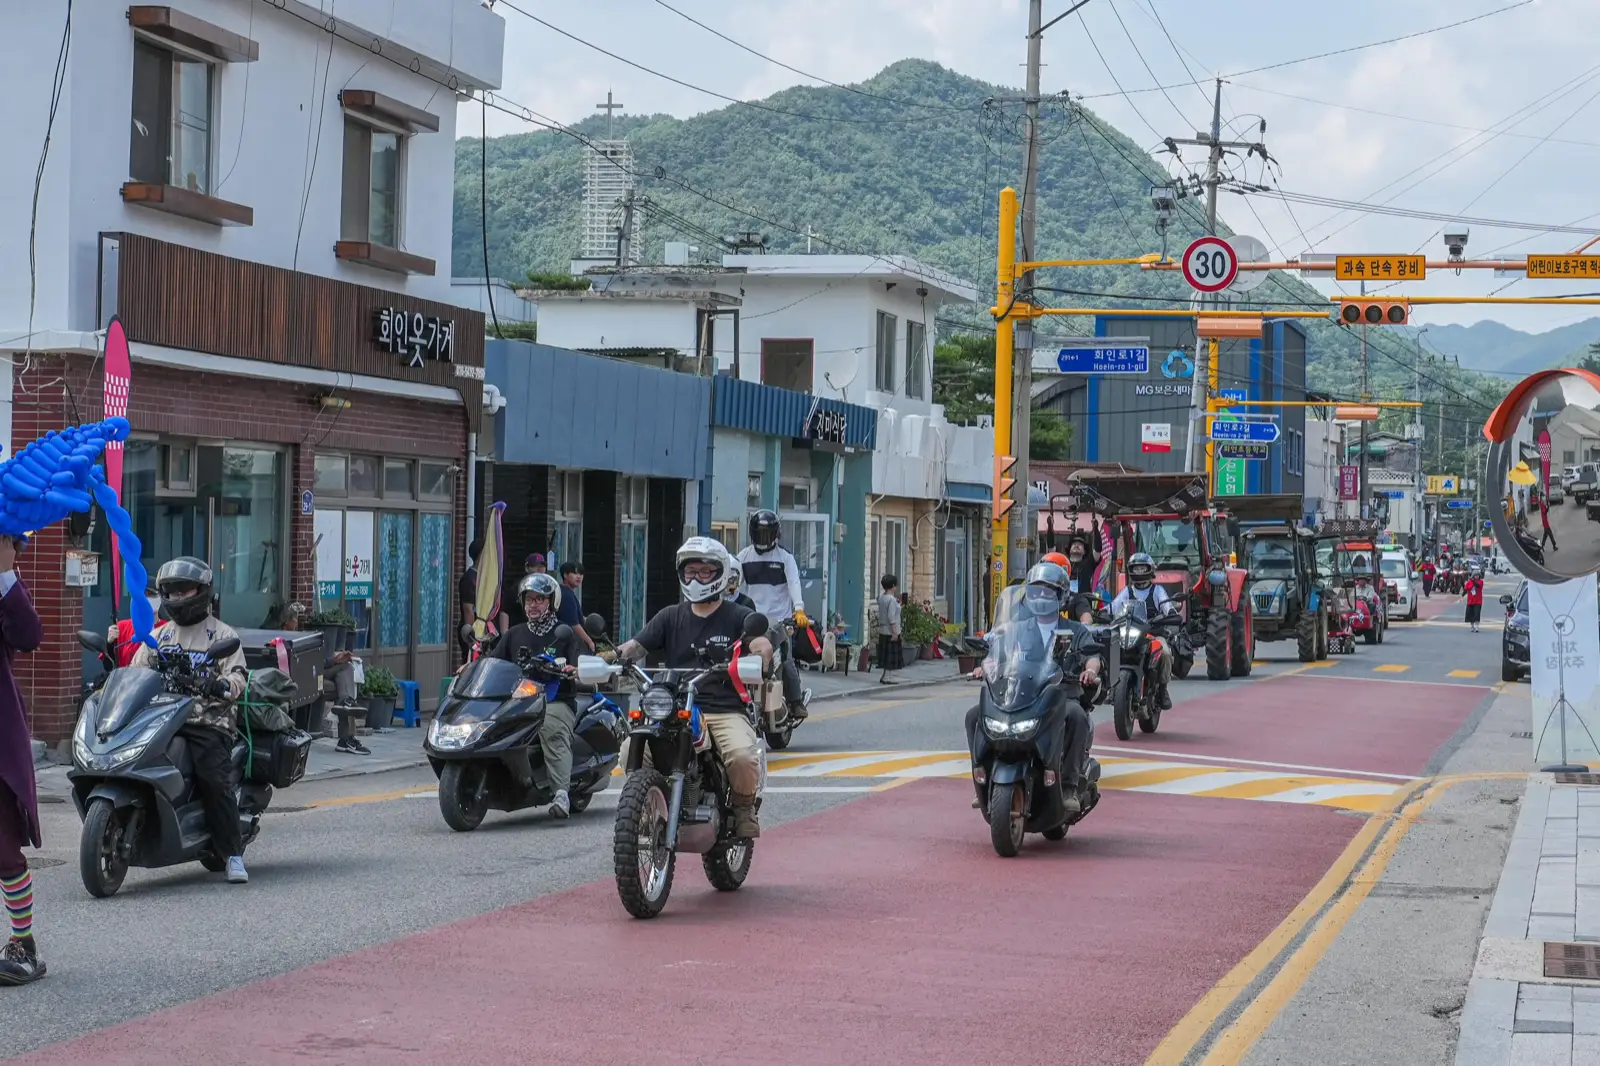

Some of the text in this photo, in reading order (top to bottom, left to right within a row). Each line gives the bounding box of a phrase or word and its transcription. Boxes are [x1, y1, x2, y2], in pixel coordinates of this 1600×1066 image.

[1195, 250, 1226, 279] 30
[1343, 259, 1419, 276] 과속 단속 장비
[1529, 259, 1587, 274] 어린이보호구역
[378, 306, 455, 368] 회인옷가게
[1094, 349, 1145, 362] 회인로1길
[1093, 363, 1144, 372] Hoein-ro 1-gil
[1135, 385, 1194, 396] MG보은새마
[1214, 423, 1250, 433] 회인로2길
[1226, 460, 1238, 493] 은농협
